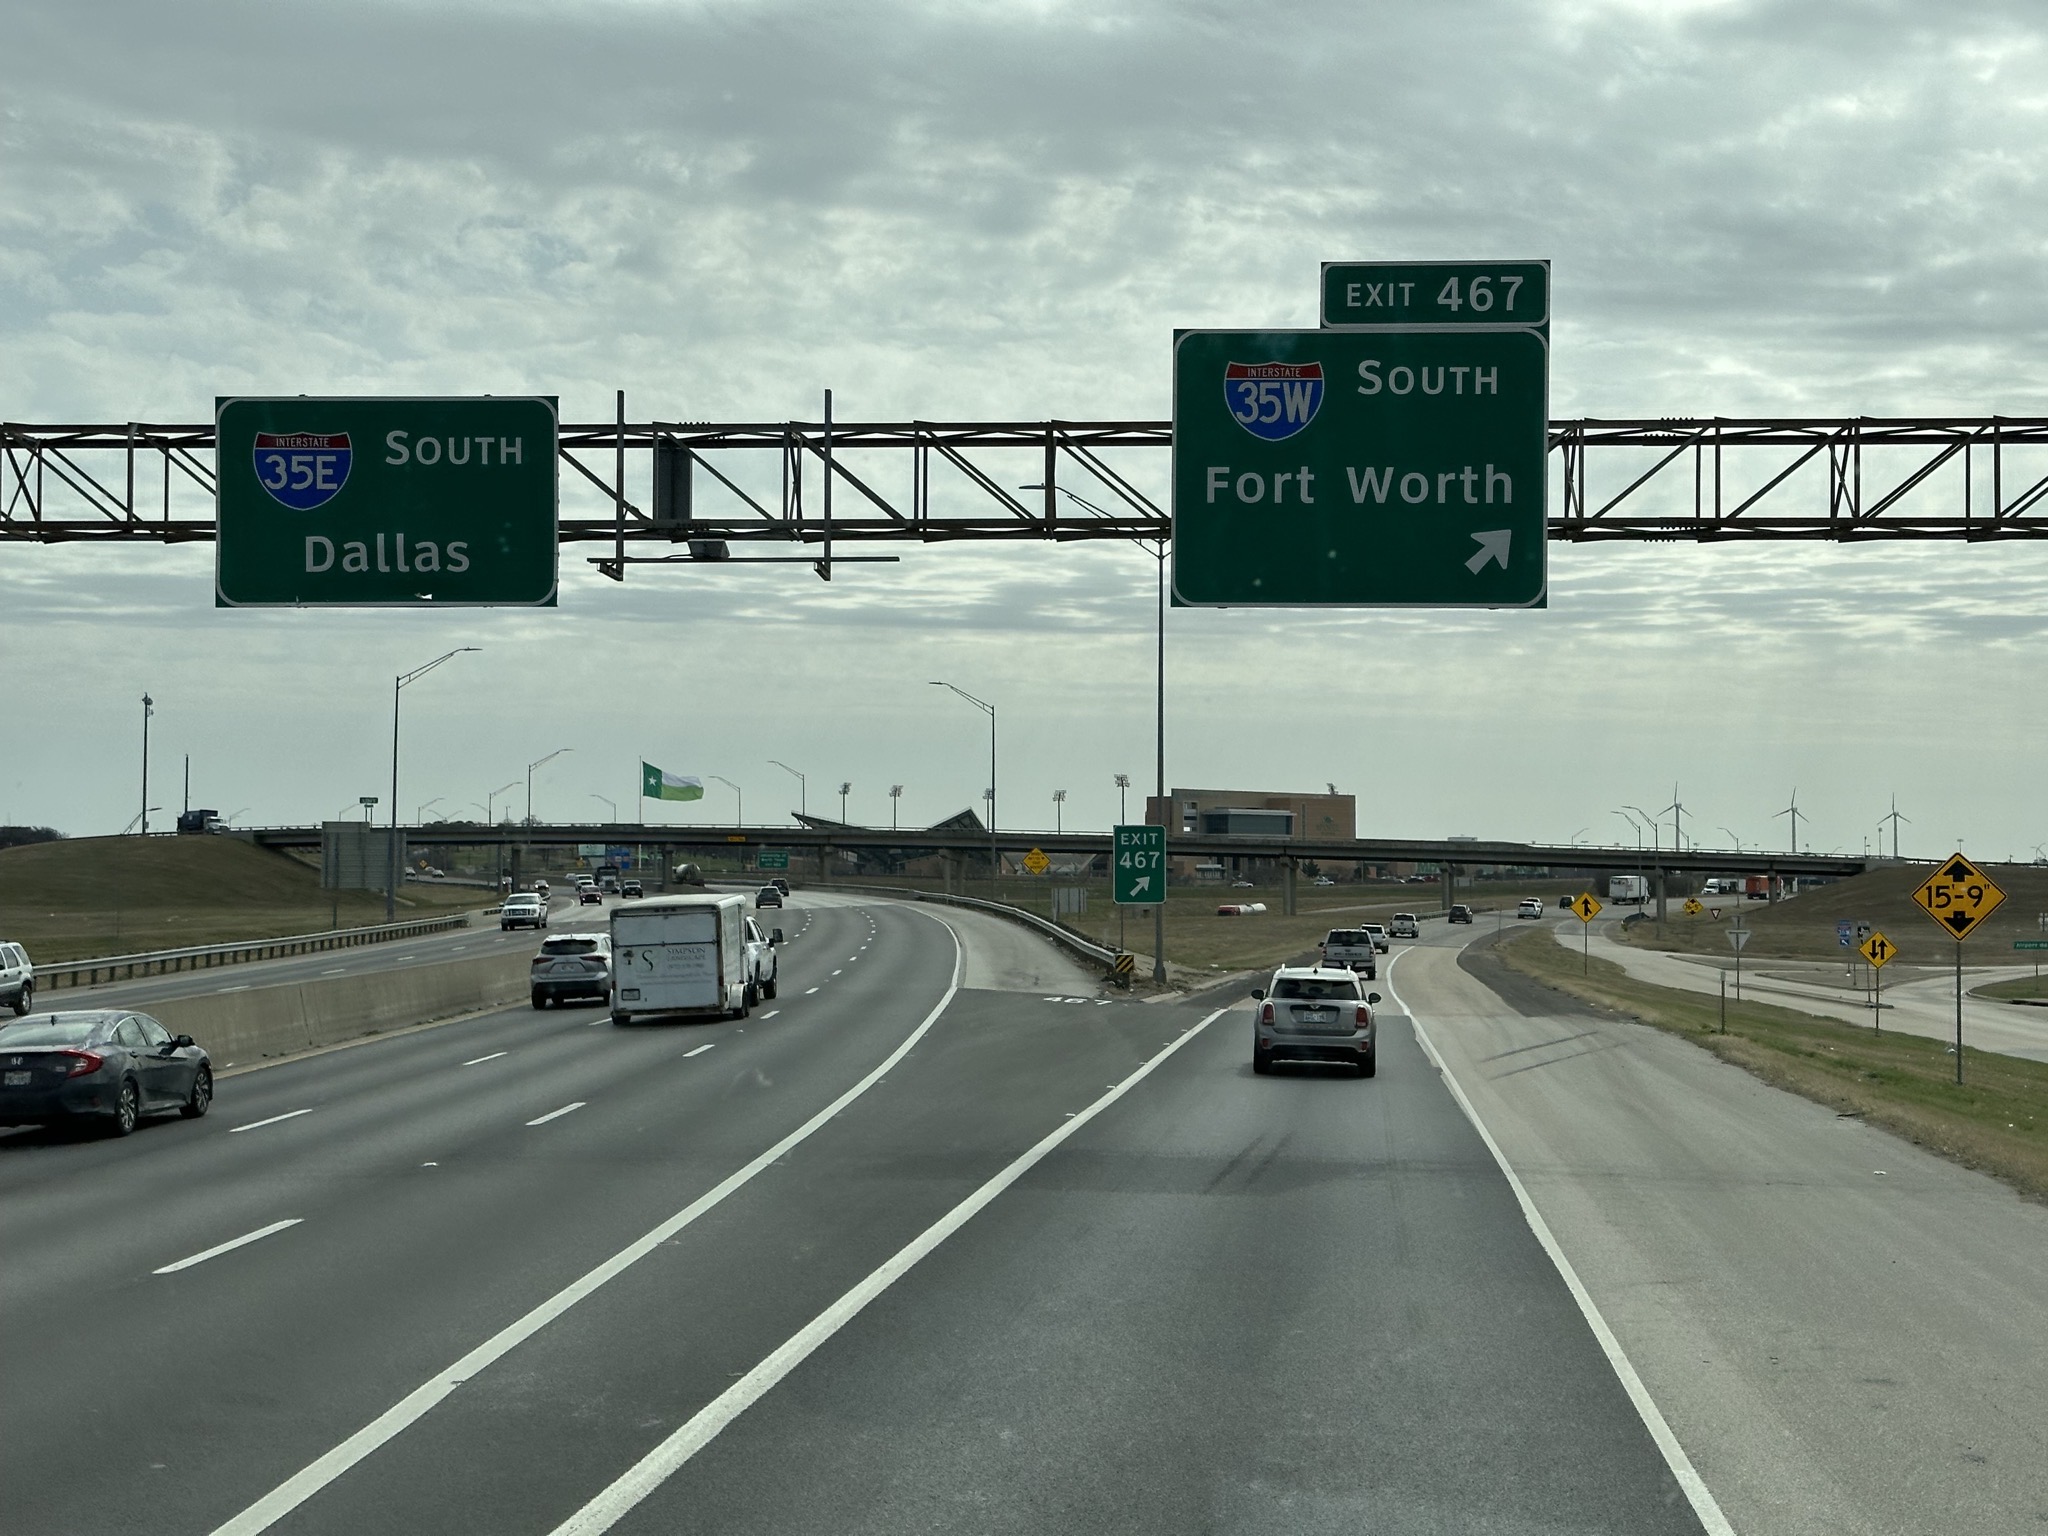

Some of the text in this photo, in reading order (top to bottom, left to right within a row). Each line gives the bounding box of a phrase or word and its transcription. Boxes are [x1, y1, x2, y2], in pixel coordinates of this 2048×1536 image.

[1346, 276, 1524, 312] EXIT 467
[1247, 367, 1301, 378] INTERSTATE
[1357, 359, 1498, 395] SOUTH
[1236, 381, 1313, 424] 35W
[276, 437, 330, 448] INTERSTATE
[385, 430, 522, 465] SOUTH
[264, 455, 338, 490] 35E
[1206, 464, 1512, 504] Fort Worth
[305, 533, 470, 573] Dallas
[1120, 833, 1158, 845] EXIT
[1119, 851, 1160, 869] 467
[666, 947, 706, 955] SIMPSON
